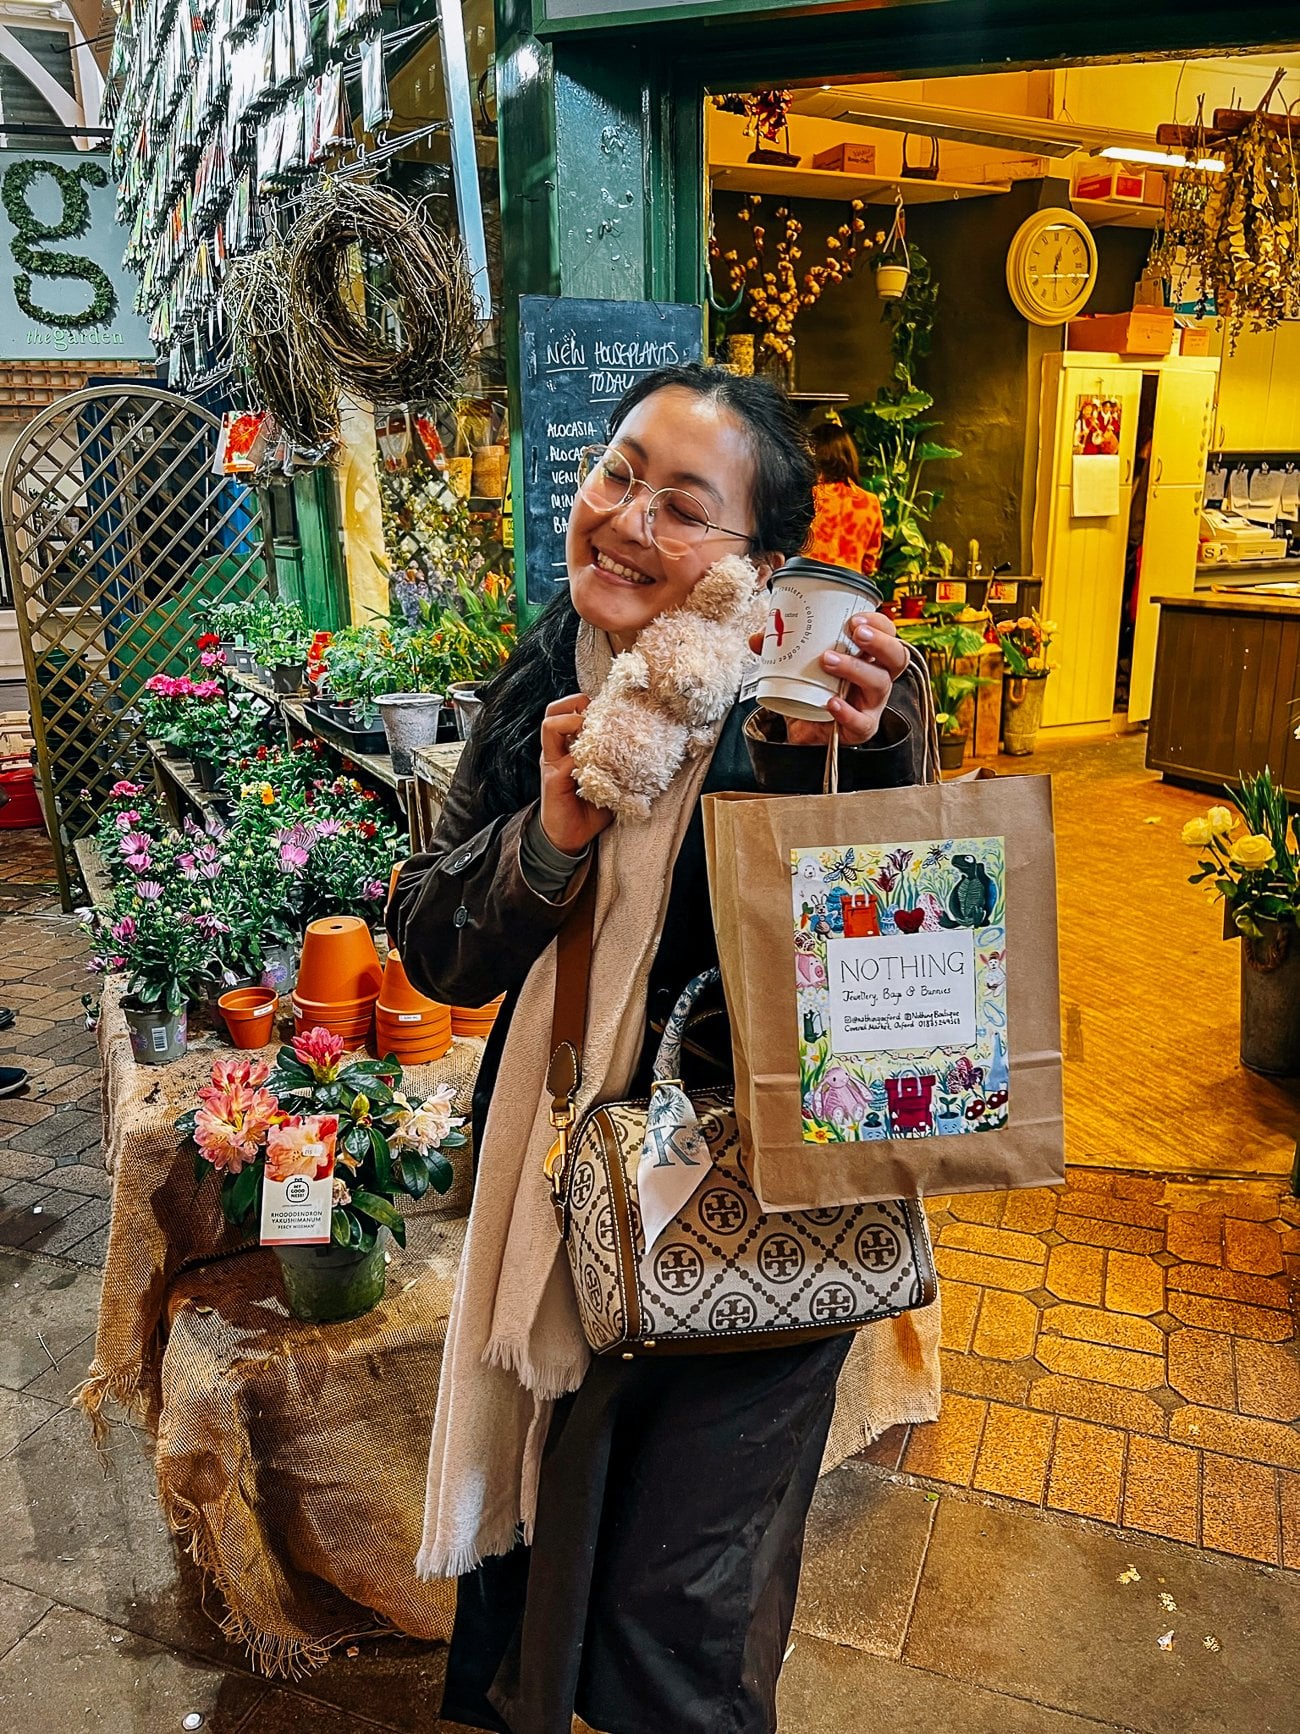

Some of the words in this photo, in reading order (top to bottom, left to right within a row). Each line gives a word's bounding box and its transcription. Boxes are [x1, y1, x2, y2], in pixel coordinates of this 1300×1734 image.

[2, 159, 118, 326] g
[544, 338, 585, 365] NEW
[594, 341, 679, 367] HOUSEPLANTS
[549, 445, 586, 462] ALOCAS
[553, 516, 569, 534] BA
[840, 951, 965, 983] NOTHING
[920, 984, 951, 997] Bunnies
[648, 1124, 701, 1168] K
